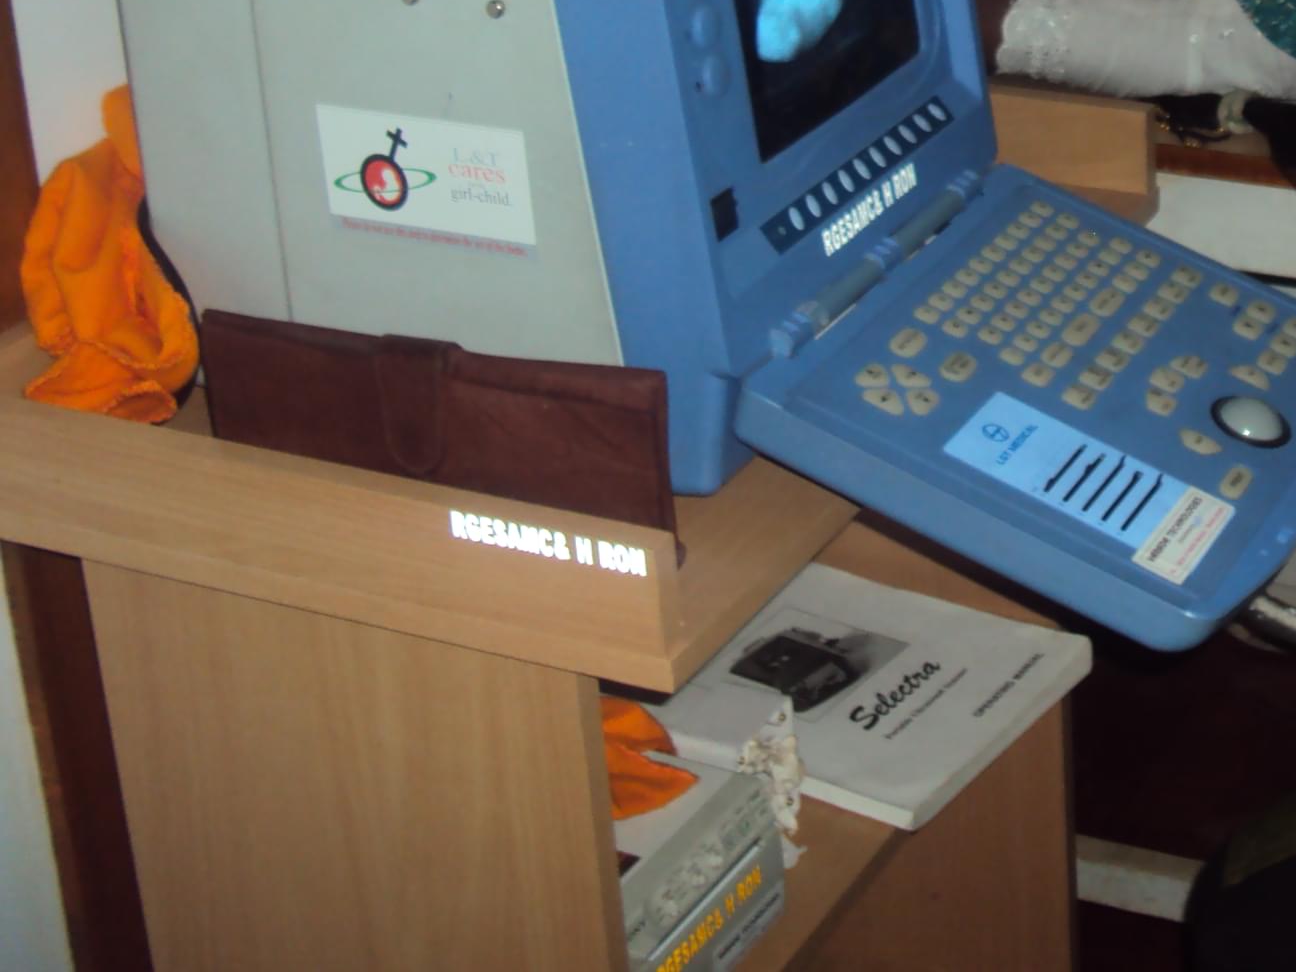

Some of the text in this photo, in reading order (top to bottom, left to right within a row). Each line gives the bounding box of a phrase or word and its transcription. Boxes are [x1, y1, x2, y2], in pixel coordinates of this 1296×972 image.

[447, 163, 506, 185] cares
[449, 509, 571, 561] RGESAMC&
[574, 533, 594, 566] H
[849, 661, 941, 732] Selectra
